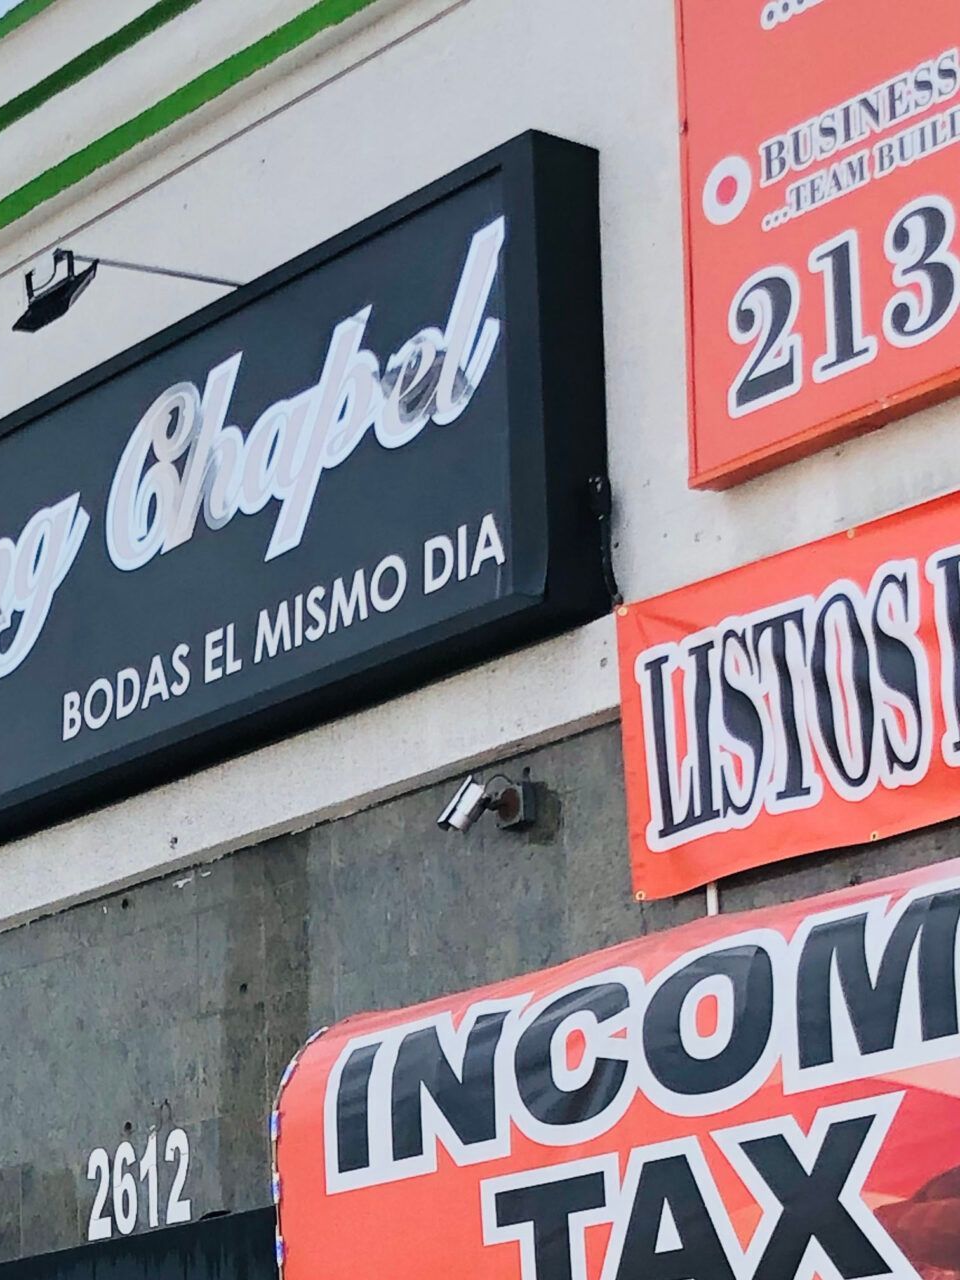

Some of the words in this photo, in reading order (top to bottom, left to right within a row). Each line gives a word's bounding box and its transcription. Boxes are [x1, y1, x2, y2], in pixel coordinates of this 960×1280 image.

[762, 53, 958, 184] BUSINESS
[105, 215, 506, 572] Chapel
[735, 205, 954, 409] 213
[61, 644, 191, 742] BODAS
[203, 623, 243, 685] EL
[253, 555, 408, 664] MISMO
[423, 514, 506, 596] DIA
[645, 573, 923, 838] LISTOS
[88, 1127, 192, 1241] 2612
